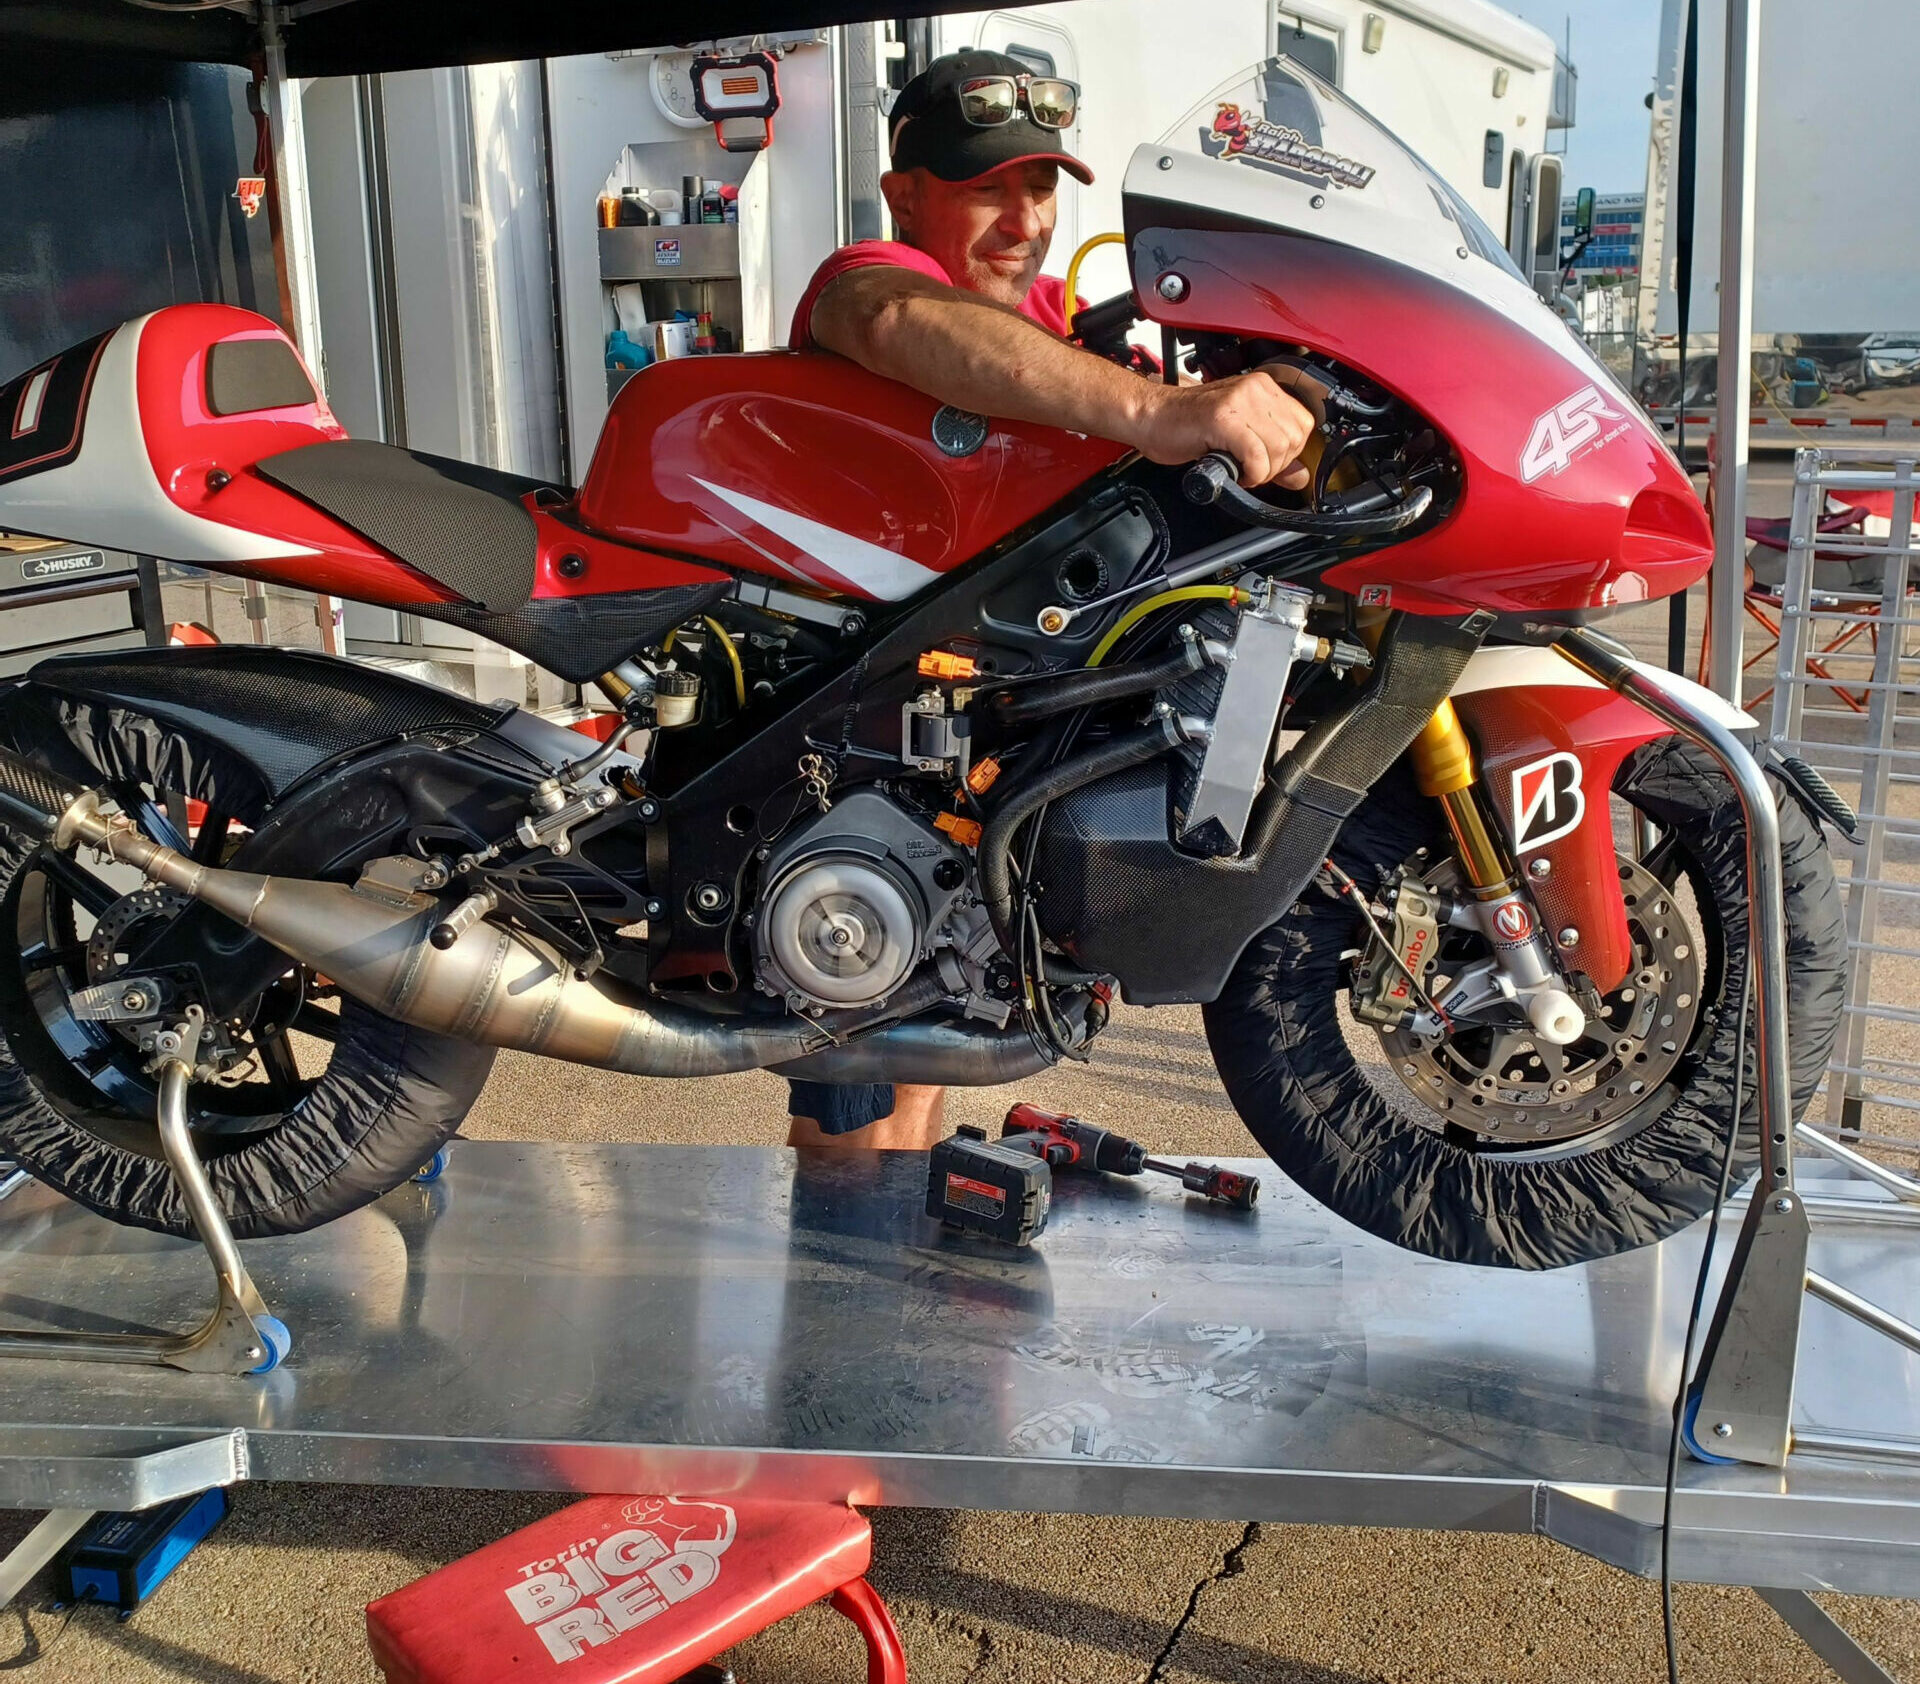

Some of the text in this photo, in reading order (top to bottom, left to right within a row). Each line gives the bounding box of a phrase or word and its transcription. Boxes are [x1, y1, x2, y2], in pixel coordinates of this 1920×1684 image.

[1256, 121, 1300, 143] Ralph
[50, 555, 93, 572] HUSKY
[1390, 929, 1428, 998] brmbo
[504, 1529, 673, 1626] BIG
[517, 1537, 599, 1579] Torin
[533, 1549, 721, 1665] RED
